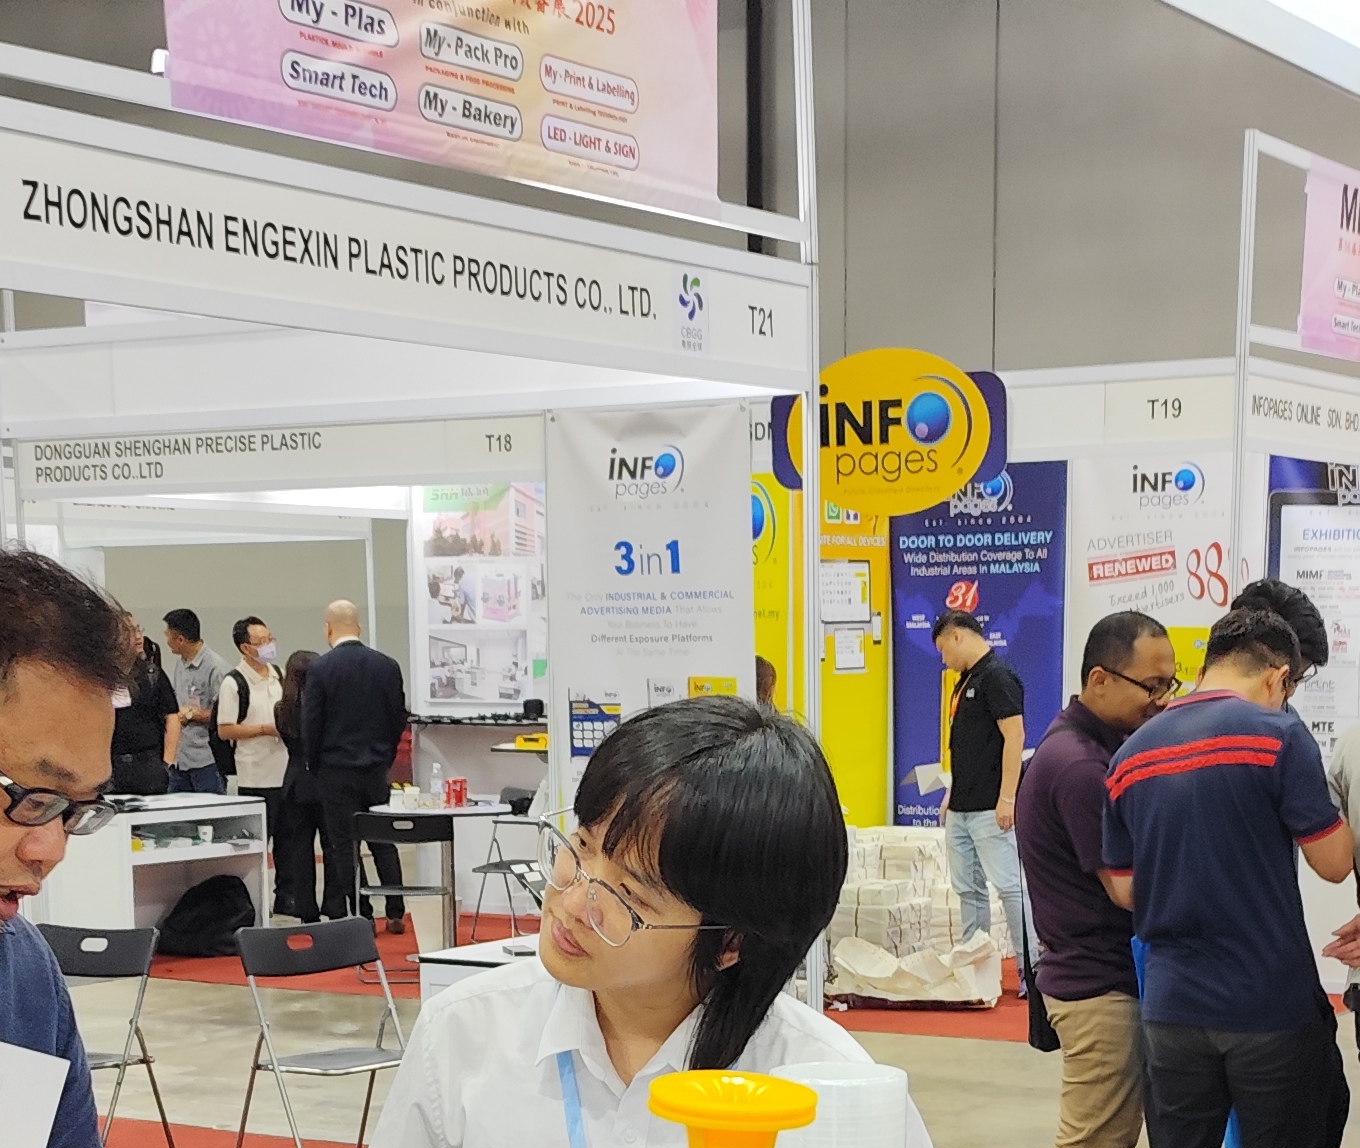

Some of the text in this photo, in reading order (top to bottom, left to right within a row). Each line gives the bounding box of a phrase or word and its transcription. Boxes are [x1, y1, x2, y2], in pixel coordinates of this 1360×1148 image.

[290, 0, 386, 36] My Plas
[576, 1, 616, 35] 2025
[425, 28, 518, 71] My Pack Pro
[289, 59, 344, 92] Smart
[350, 75, 389, 102] Tech
[545, 63, 635, 105] My Print & Labelling
[424, 90, 448, 118] My
[462, 98, 518, 135] Bakery
[547, 125, 636, 160] LED LIGHT & SIGN
[21, 178, 657, 320] ZHONGSHAN ENGEXIN PLASTIC PRODUCTS CO., LTD.
[748, 305, 774, 338] T21
[1147, 398, 1182, 420] T19
[1252, 395, 1293, 423] INFOPAGES
[1296, 404, 1321, 426] ONLINE
[34, 432, 322, 462] DONGGUAN SHENGHAN PRECISE PLASTIC
[485, 434, 513, 454] T18
[35, 463, 108, 484] PRODUCTS
[836, 449, 938, 485] pages
[615, 481, 667, 500] pages
[1139, 493, 1189, 510] pages
[899, 530, 1053, 549] DOOR TO DOOR DELIVERY
[1087, 529, 1173, 552] ADVERTISER
[903, 547, 1048, 564] Wide Distribution Coverage To All
[1092, 553, 1174, 579] RENEWED
[910, 564, 950, 577] Industrial
[952, 564, 978, 576] Areas
[990, 562, 1041, 574] MALAYSIA
[605, 592, 657, 602] INDUSTRIAL
[670, 590, 734, 600] COMMERCIAL
[1109, 586, 1148, 607] Exceed
[580, 605, 671, 616] ADVERTISING MEDIA
[591, 633, 713, 646] Different Exposure Platforms
